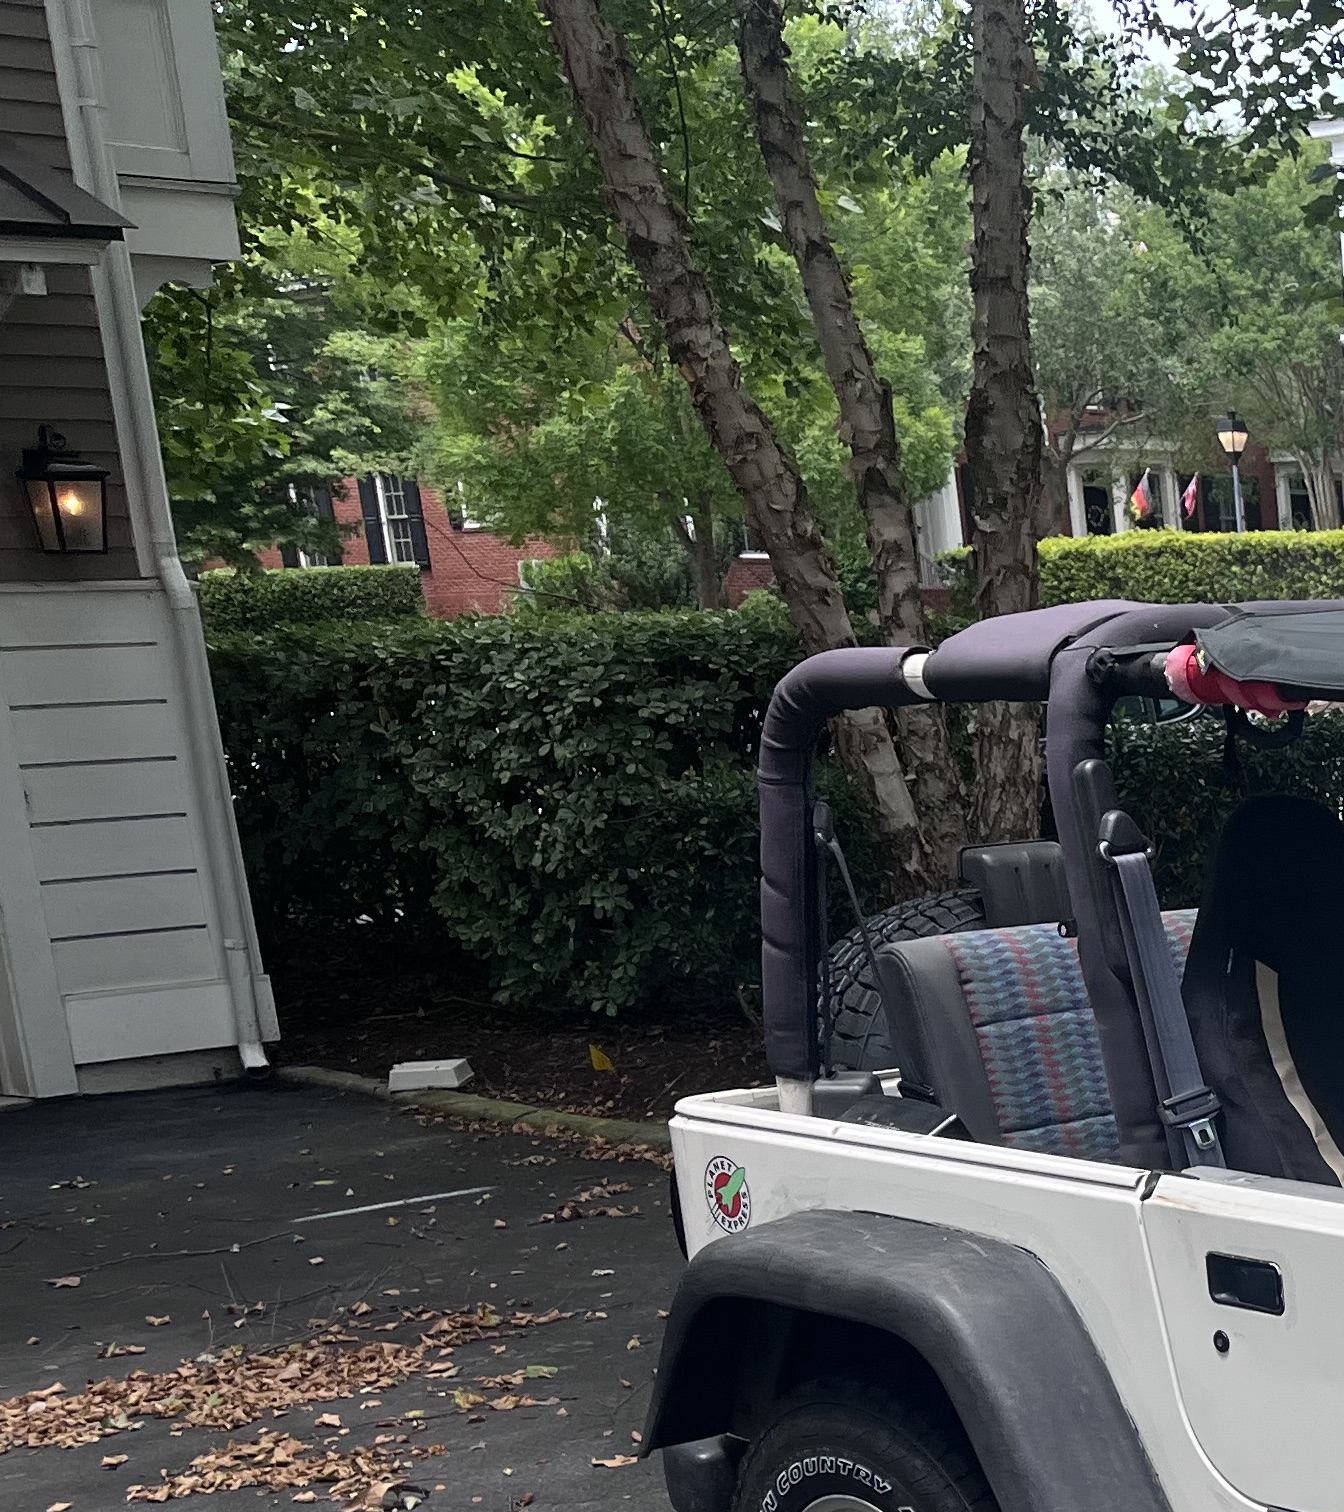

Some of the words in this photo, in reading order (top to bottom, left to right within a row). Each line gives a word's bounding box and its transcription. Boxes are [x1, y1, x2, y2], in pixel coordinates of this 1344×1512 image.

[707, 1160, 732, 1199] PLANET
[721, 1191, 748, 1230] EXPRESS
[777, 1456, 892, 1494] COUNTRY
